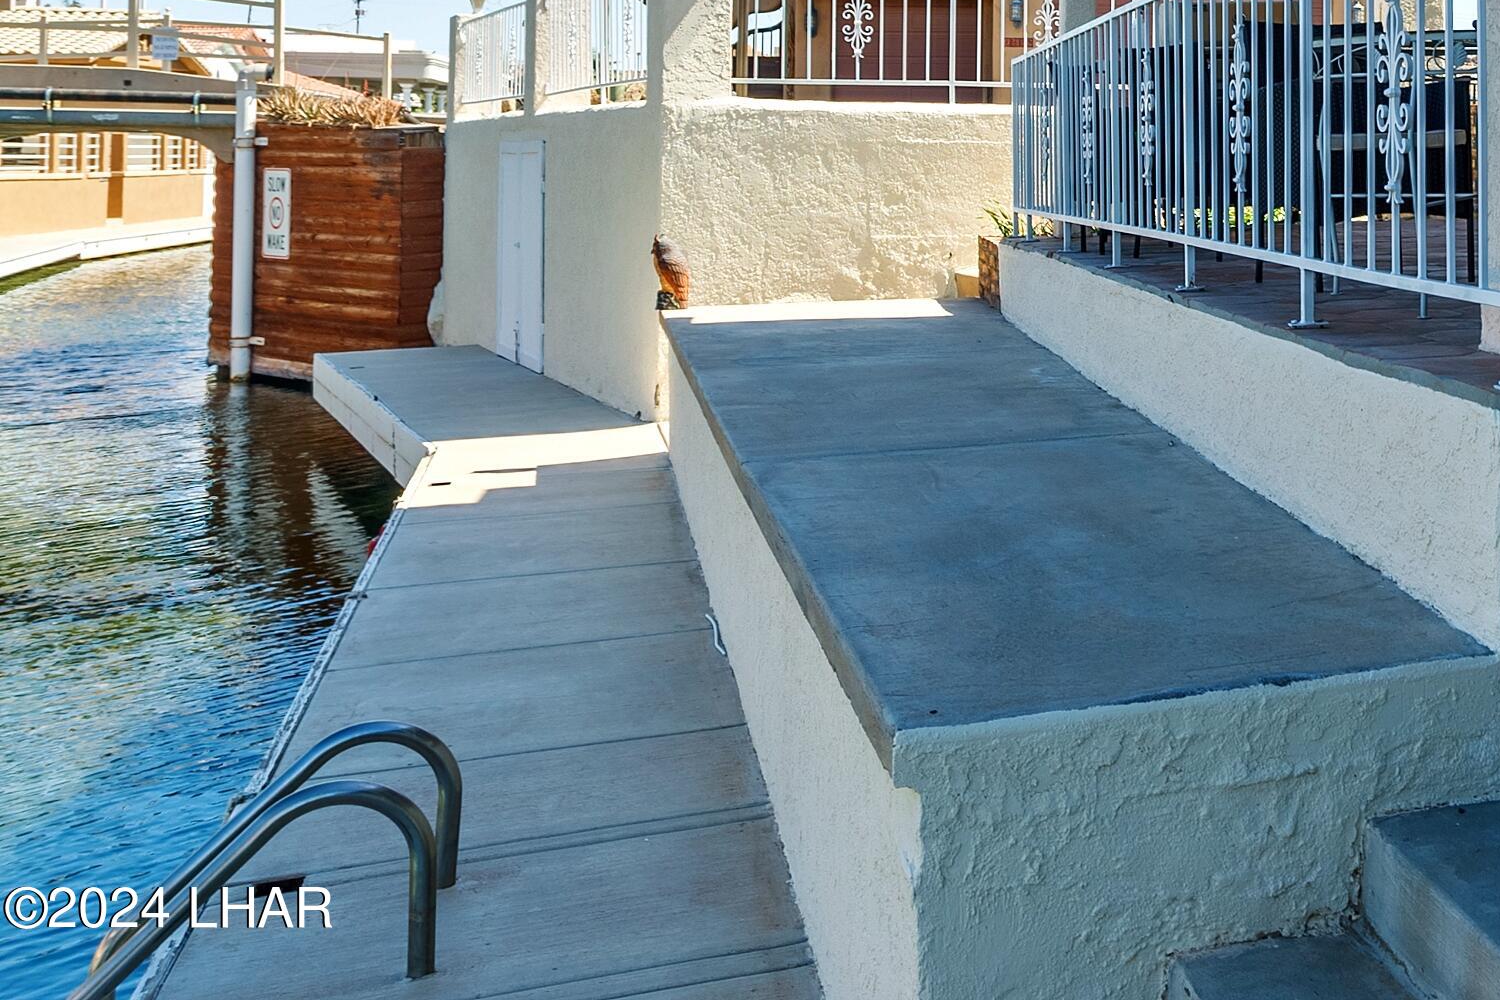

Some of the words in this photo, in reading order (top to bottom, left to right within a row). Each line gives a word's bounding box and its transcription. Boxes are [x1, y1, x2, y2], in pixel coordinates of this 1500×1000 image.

[267, 176, 286, 192] SLOW
[272, 206, 281, 220] NO
[267, 234, 286, 250] WAKE
